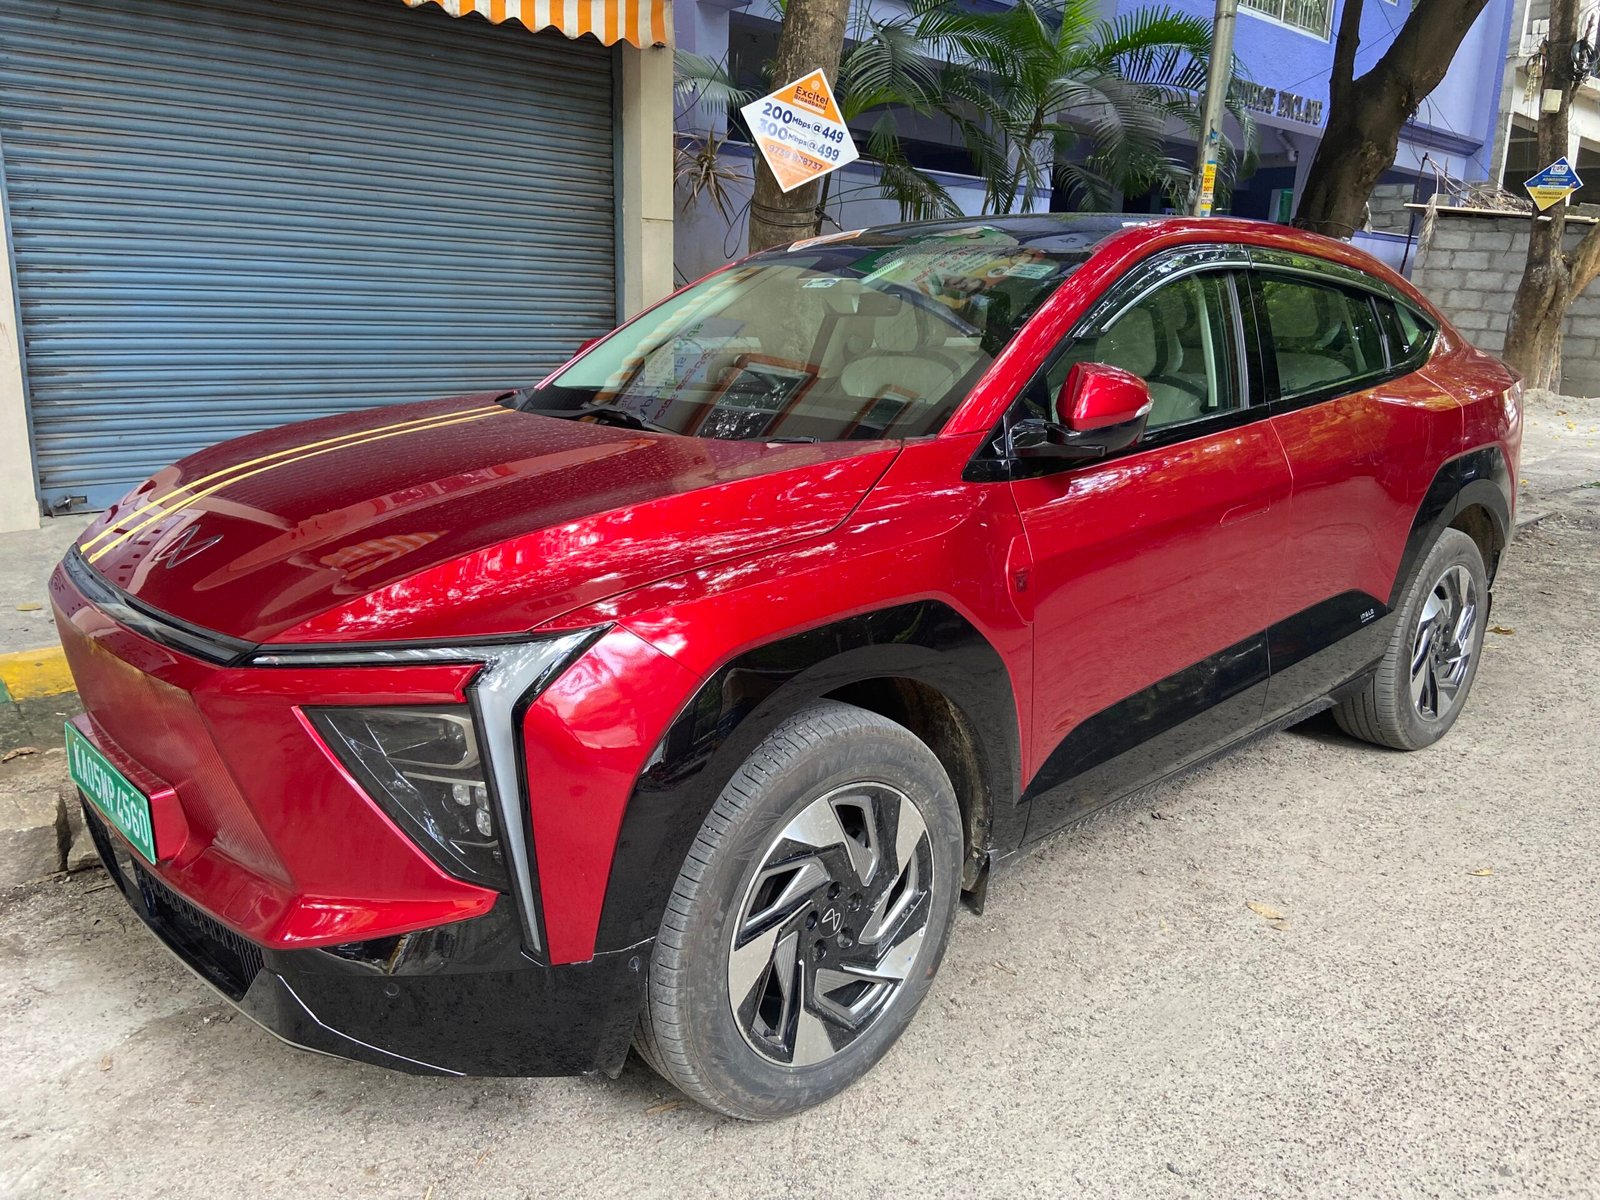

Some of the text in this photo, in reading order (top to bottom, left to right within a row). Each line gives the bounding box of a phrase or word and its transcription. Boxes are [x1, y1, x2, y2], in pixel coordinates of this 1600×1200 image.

[793, 94, 827, 110] Broadband
[795, 86, 829, 105] Excitel
[116, 785, 149, 847] 4560
